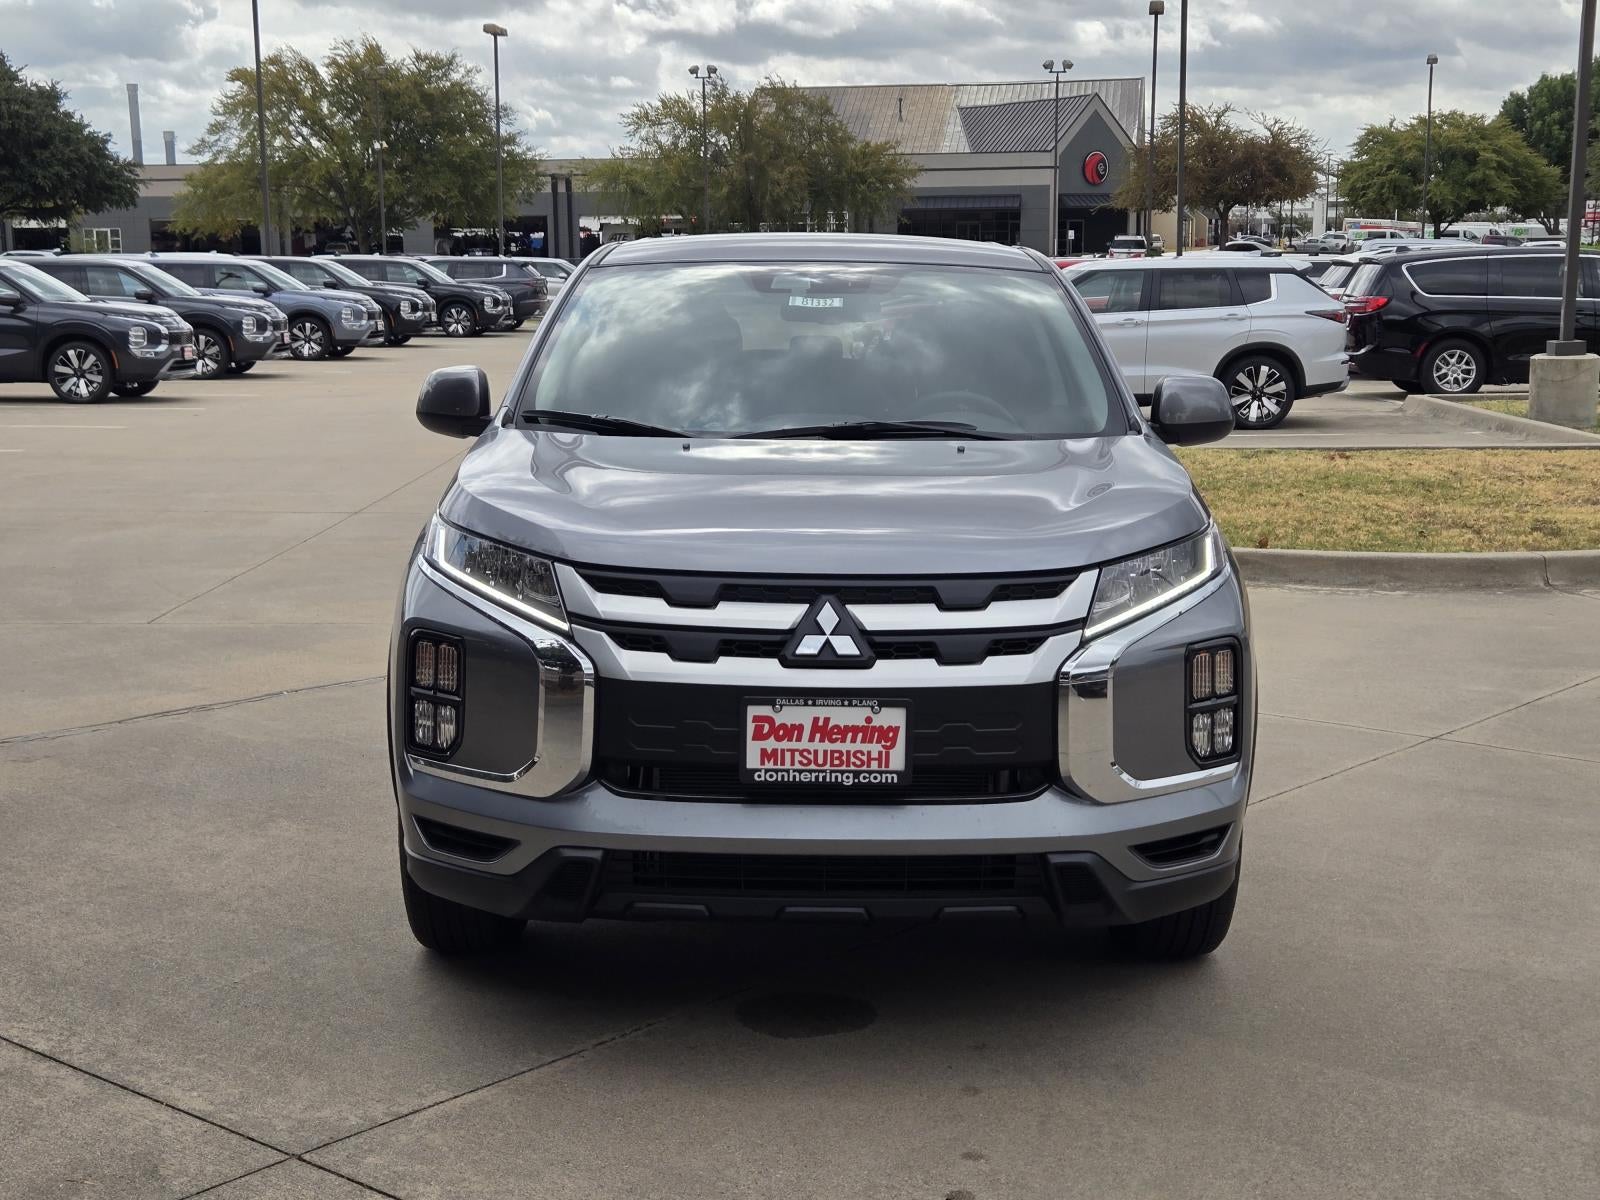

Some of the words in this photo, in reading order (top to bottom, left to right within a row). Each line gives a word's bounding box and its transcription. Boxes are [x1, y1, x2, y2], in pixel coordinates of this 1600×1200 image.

[752, 715, 804, 743] Don
[808, 715, 900, 751] Herring
[760, 748, 890, 769] MITSUBISHI
[754, 769, 898, 786] donherring.com
